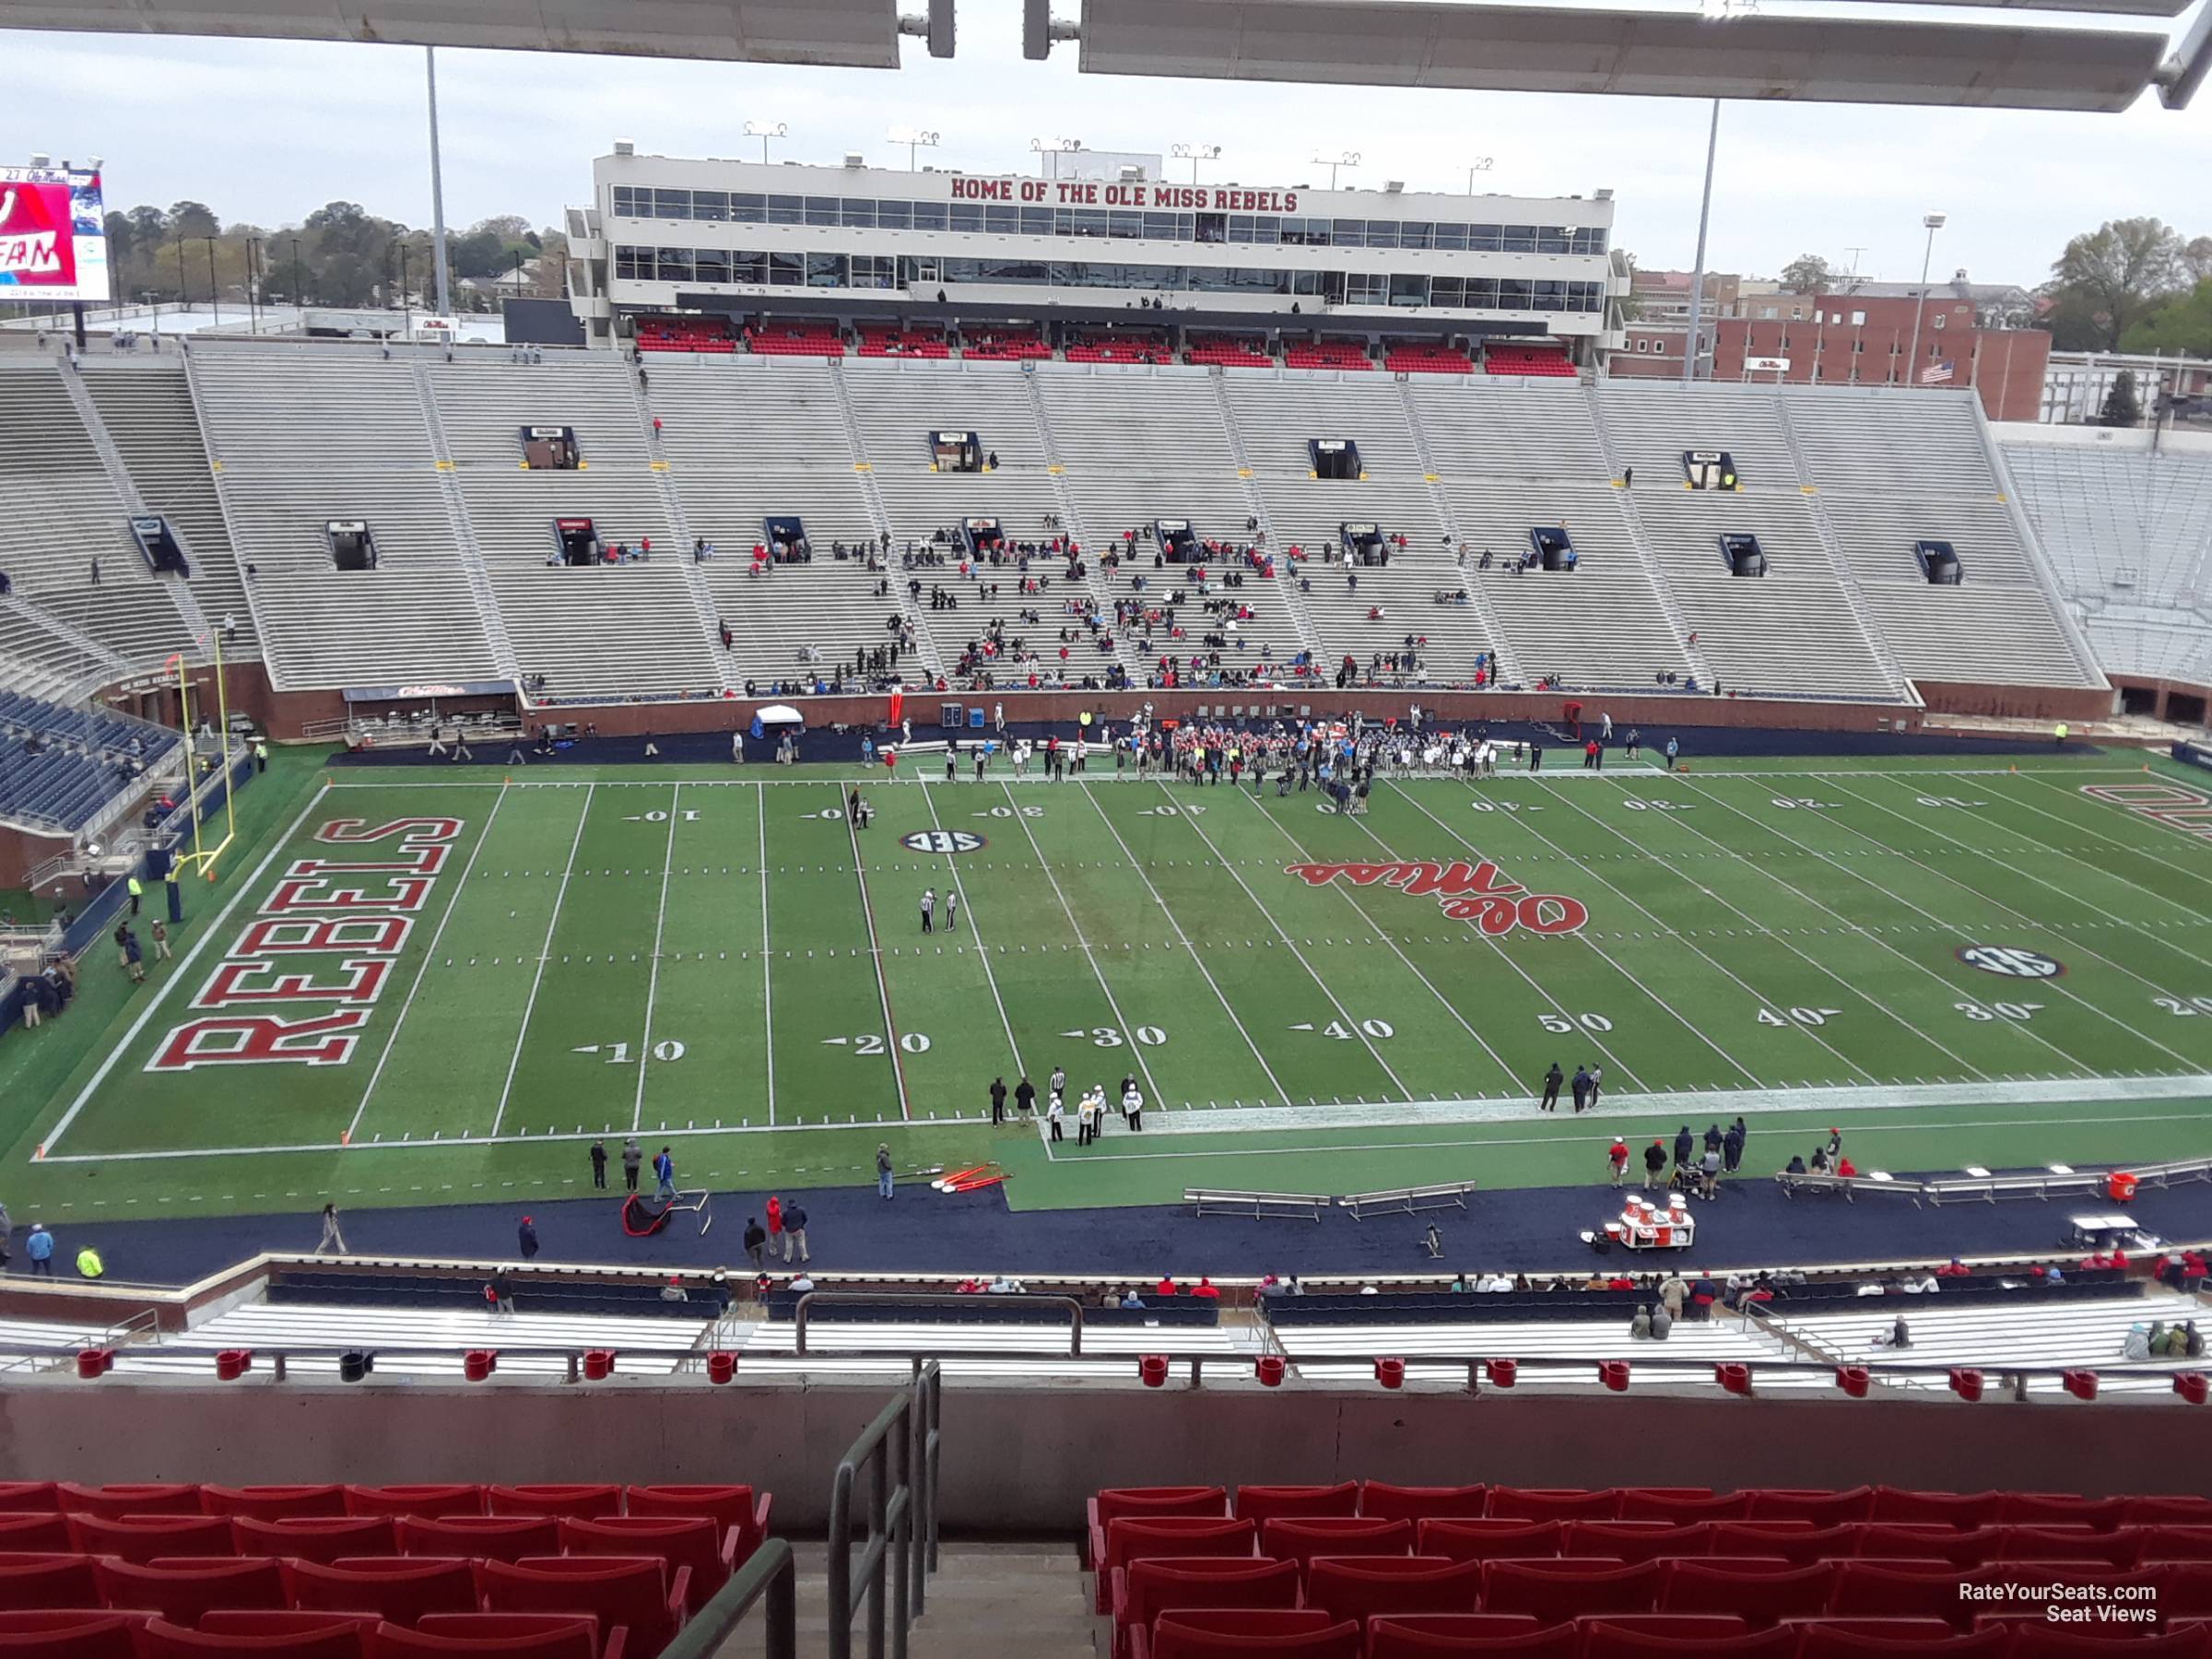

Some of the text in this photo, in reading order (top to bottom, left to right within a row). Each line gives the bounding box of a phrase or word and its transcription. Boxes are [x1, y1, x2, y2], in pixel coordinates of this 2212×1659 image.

[951, 178, 1298, 212] HOME OF THE OLE MISS REBELS
[991, 806, 1045, 818] 30
[1155, 804, 1207, 817] 40
[1471, 801, 1521, 812] 40
[1623, 799, 1677, 811] 30
[1771, 798, 1827, 808] 20
[644, 809, 701, 822] 10
[906, 831, 981, 853] SEC
[1283, 860, 1589, 935] Ole Miss
[143, 817, 465, 1072] REBELS
[1964, 947, 2057, 977] SEC
[1757, 1006, 1826, 1027] 40
[1953, 1001, 2032, 1022] 30
[1323, 1018, 1395, 1040] 40
[1536, 1013, 1613, 1033] 50
[853, 1031, 932, 1055] 20
[1091, 1025, 1168, 1047] 30
[603, 1040, 687, 1065] 10
